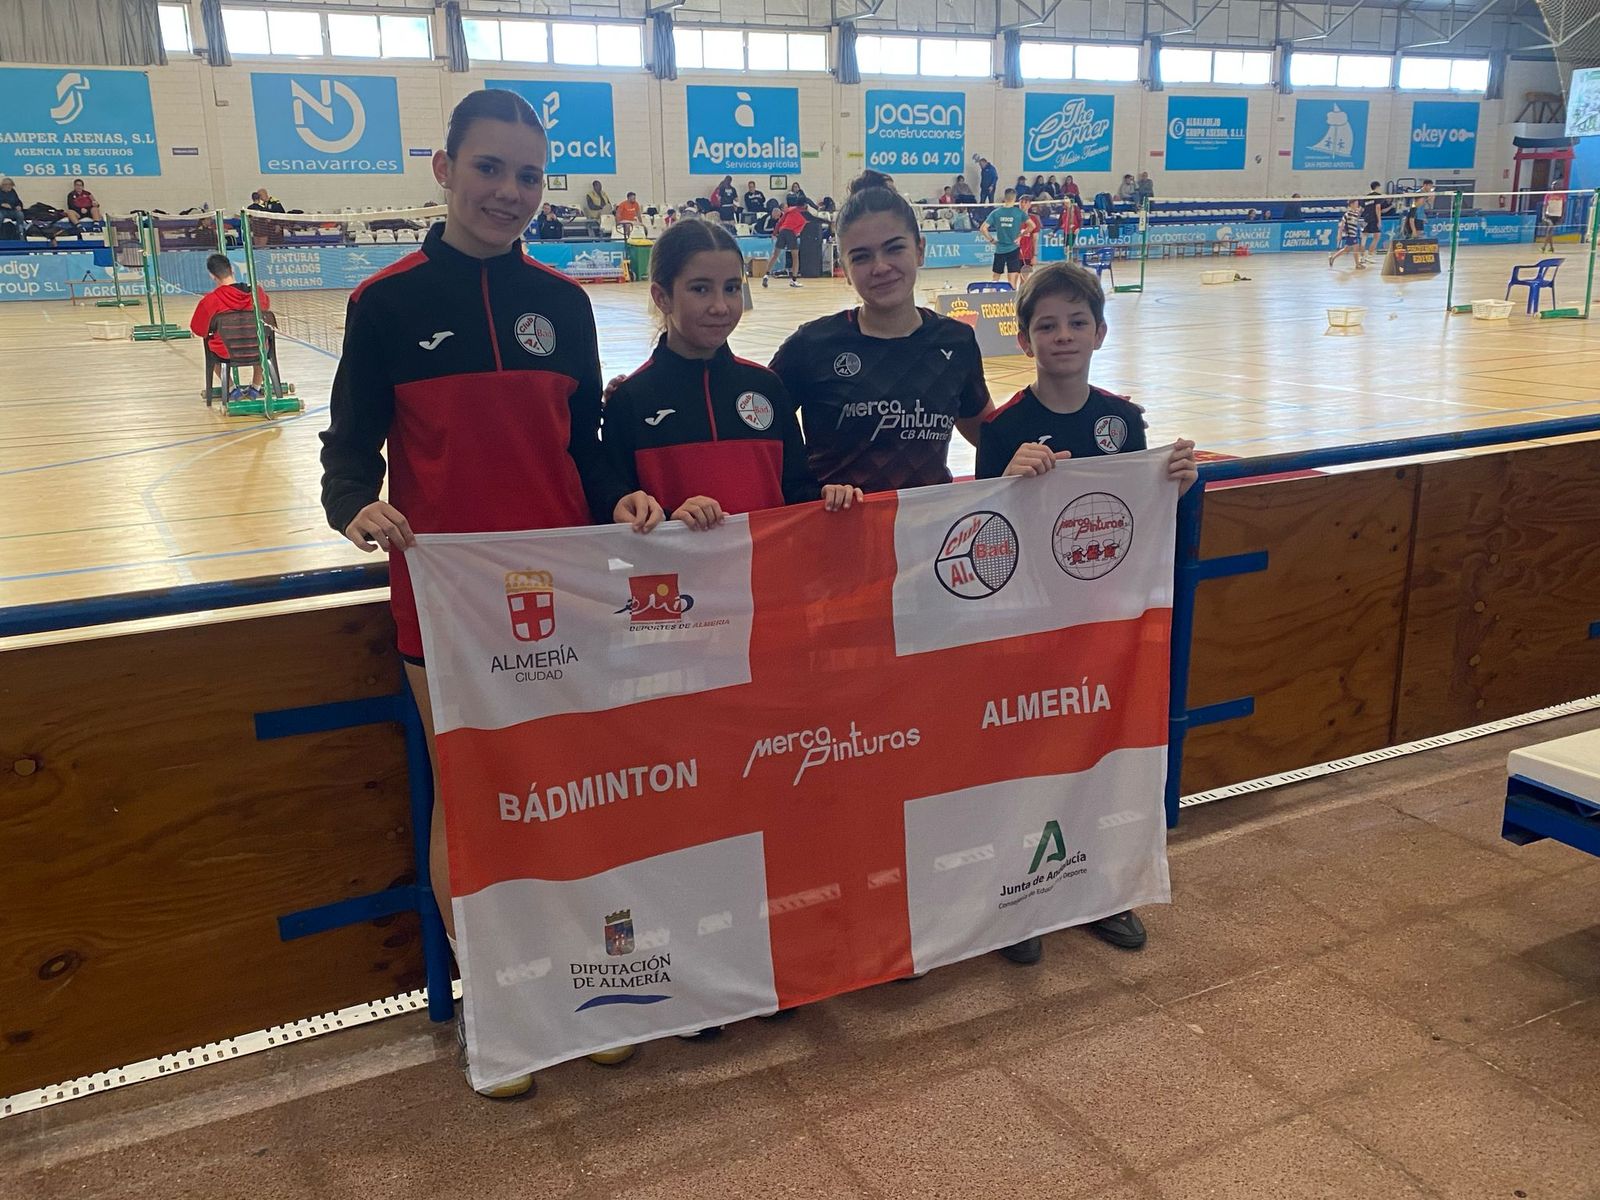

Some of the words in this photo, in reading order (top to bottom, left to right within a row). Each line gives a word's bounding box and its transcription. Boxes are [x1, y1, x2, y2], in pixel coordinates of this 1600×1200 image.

[63, 133, 128, 145] ARENAS,
[879, 126, 962, 139] construcciones
[1412, 123, 1447, 148] okey
[14, 148, 63, 156] AGENCIA
[692, 136, 799, 164] Agrobalia
[267, 159, 398, 171] esnavarro.es
[725, 160, 759, 169] Servicios
[870, 152, 897, 165] 609
[901, 152, 918, 165] 86
[922, 152, 939, 165] 04
[943, 152, 960, 165] 70
[23, 164, 56, 176] 968
[63, 164, 82, 175] 18
[88, 164, 108, 175] 56
[115, 164, 134, 175] 16
[1283, 230, 1310, 239] COMPRA
[271, 253, 320, 263] PINTURAS
[267, 265, 274, 274] Y
[276, 264, 321, 273] LACADOS
[281, 278, 323, 287] SORIANO
[519, 317, 534, 333] Club
[740, 394, 752, 410] Club
[1096, 420, 1109, 434] Club
[900, 430, 915, 440] CB
[944, 516, 981, 556] Club
[951, 561, 974, 587] Al.
[629, 623, 677, 632] DEPORTES
[491, 644, 578, 672] ALMERÍA
[515, 669, 563, 682] CIUDAD
[981, 676, 1111, 729] ALMERÍA
[499, 759, 699, 824] BÁDMINTON
[1062, 868, 1088, 879] Deporte
[1000, 881, 1031, 897] Junta
[1032, 874, 1045, 886] de
[570, 953, 671, 975] DIPUTACIÓN
[573, 977, 595, 989] DE
[599, 970, 671, 988] ALMERÍA
